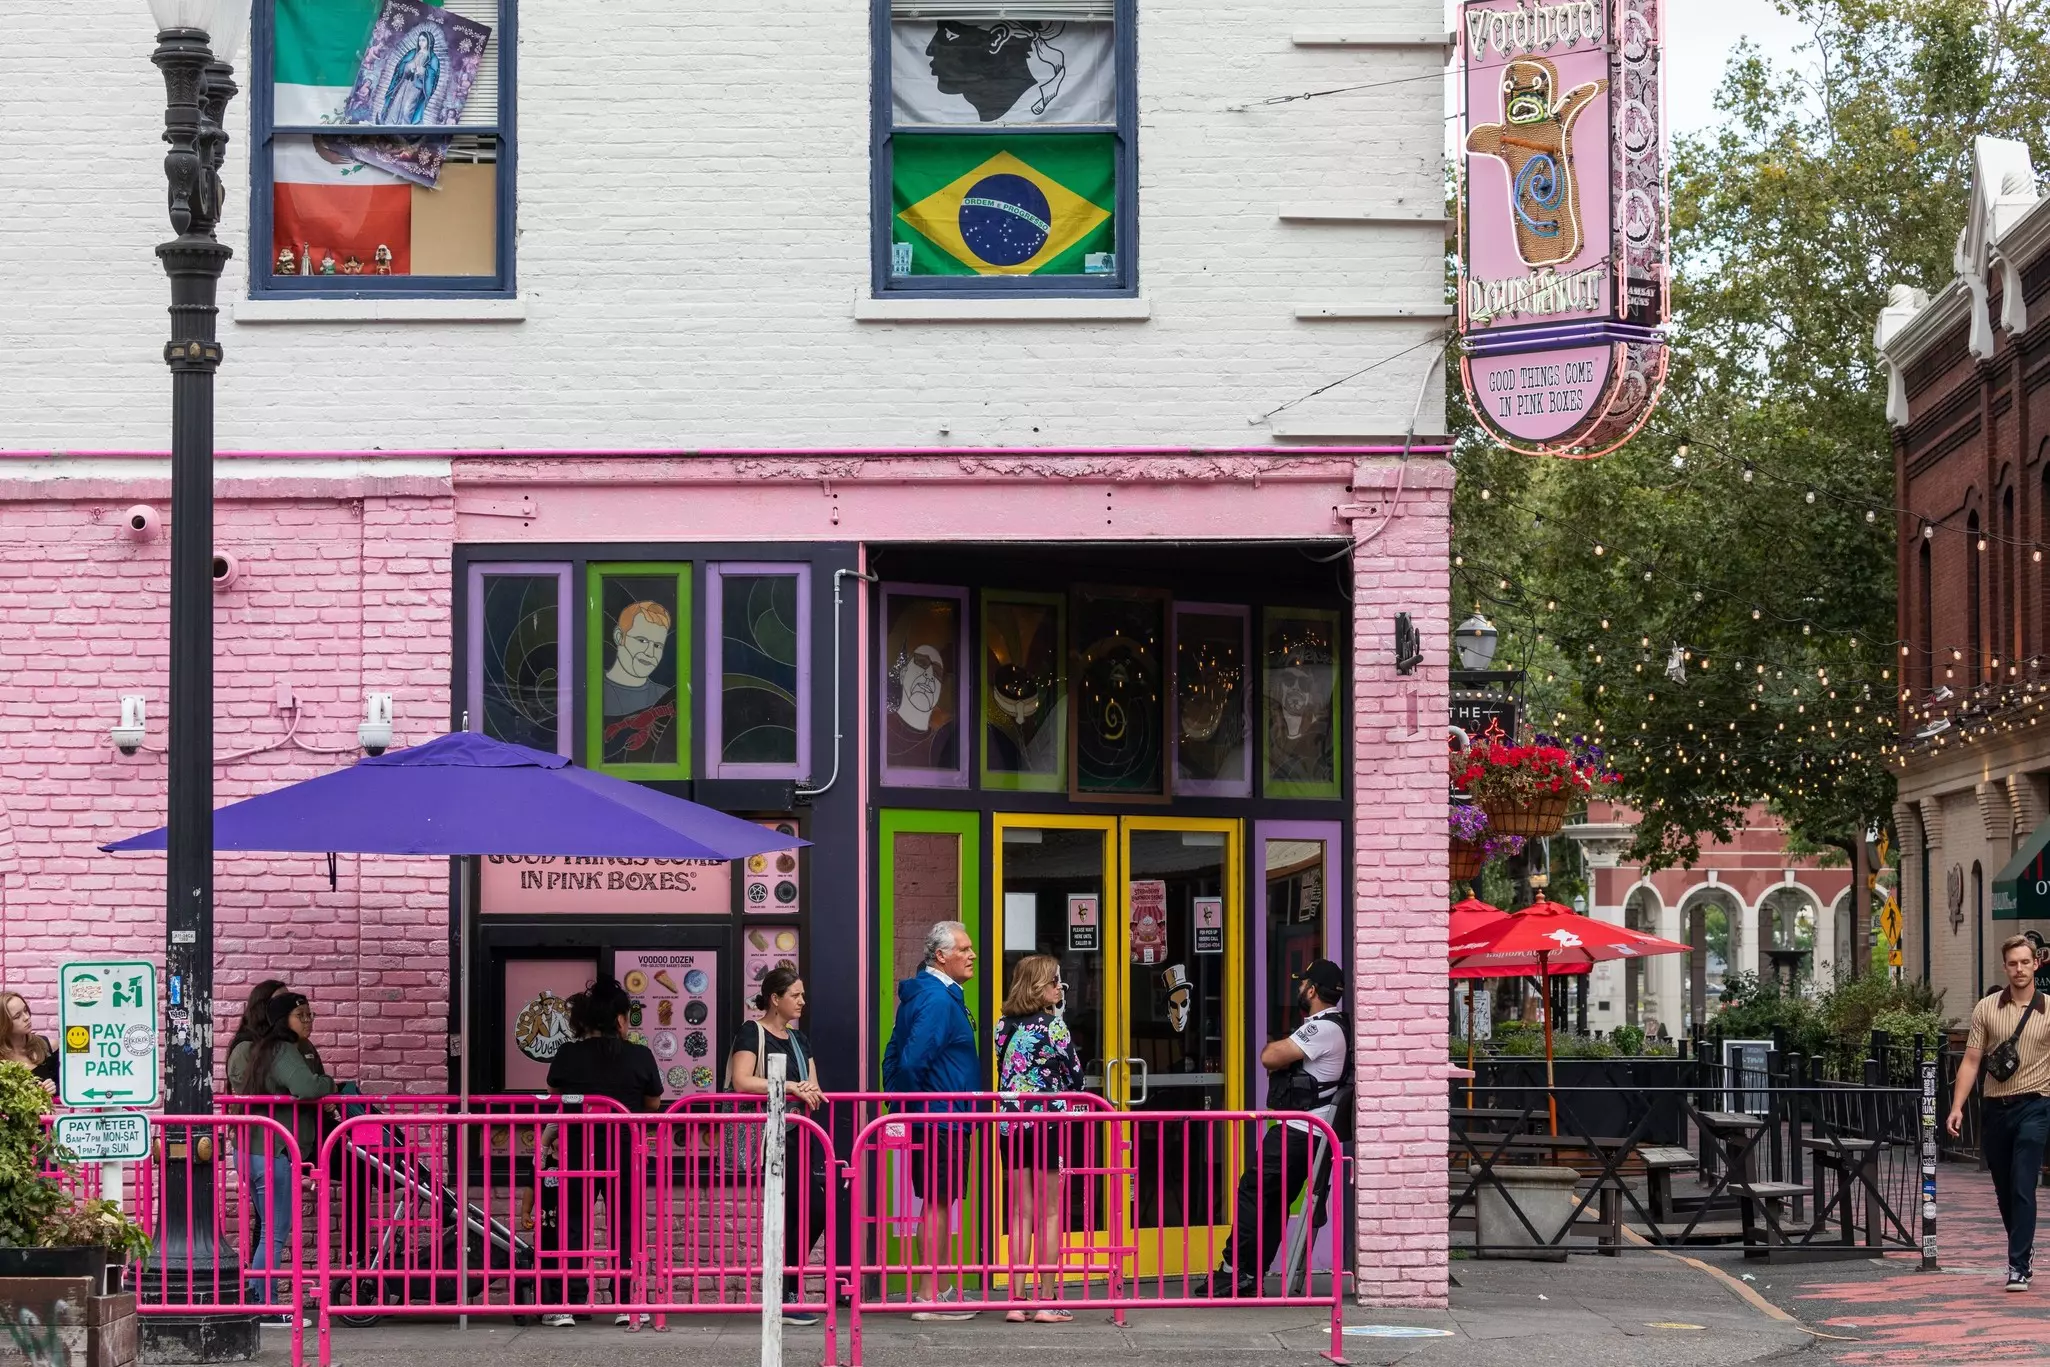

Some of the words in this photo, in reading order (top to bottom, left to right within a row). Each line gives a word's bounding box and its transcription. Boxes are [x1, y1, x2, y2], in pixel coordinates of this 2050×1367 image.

[964, 198, 994, 206] ORDEM
[1003, 204, 1049, 231] PROGRESSO
[1626, 286, 1656, 297] AMSAY
[1489, 369, 1516, 392] GOOD
[1521, 365, 1560, 389] THINGS
[1565, 361, 1593, 384] COME
[1499, 396, 1512, 417] IN
[1517, 393, 1544, 415] PINK
[1549, 389, 1584, 413] BOXES
[1449, 706, 1480, 718] THE
[521, 870, 543, 890] IN
[547, 871, 603, 890] PINK
[638, 956, 668, 964] VOODOO
[669, 956, 694, 964] DOZEN
[92, 1024, 126, 1039] PAY
[97, 1042, 121, 1058] TO
[85, 1061, 134, 1076] PARK
[69, 1122, 91, 1132] PAY
[95, 1120, 136, 1131] METER
[65, 1133, 101, 1144] 8AM-7PM
[103, 1131, 139, 1142] MON-SAT
[77, 1144, 110, 1154] 1PM-7PM
[112, 1143, 129, 1153] SUN
